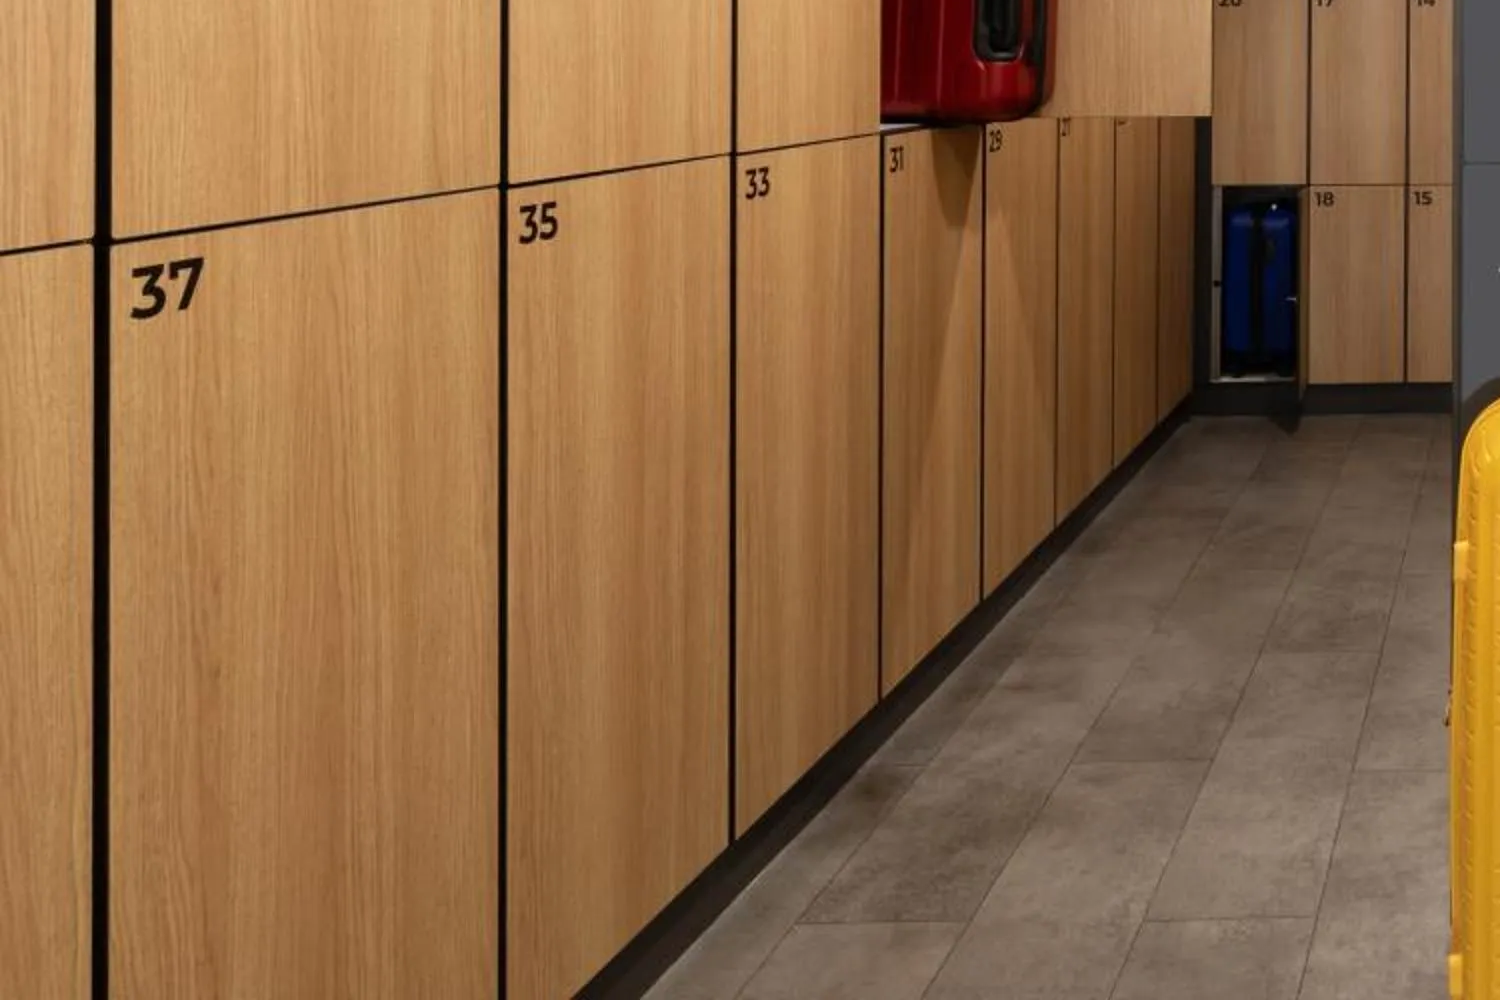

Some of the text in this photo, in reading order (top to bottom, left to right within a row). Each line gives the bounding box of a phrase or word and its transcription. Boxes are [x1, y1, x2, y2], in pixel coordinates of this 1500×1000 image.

[988, 128, 1003, 153] 29
[889, 146, 905, 174] 31
[744, 166, 771, 201] 33
[1315, 191, 1335, 206] 18
[1414, 191, 1433, 206] 15
[518, 202, 558, 245] 35
[130, 256, 205, 320] 37
